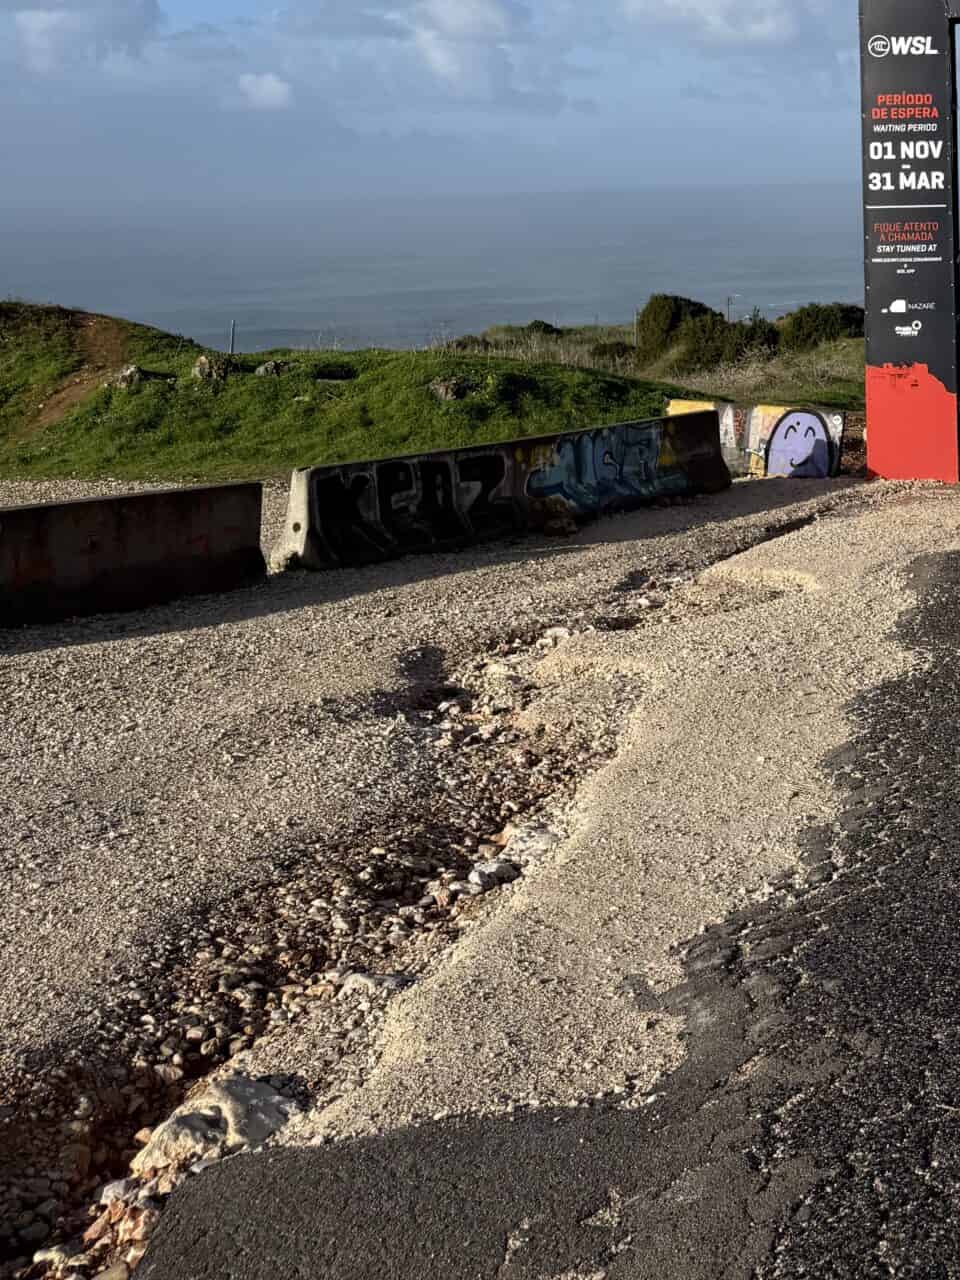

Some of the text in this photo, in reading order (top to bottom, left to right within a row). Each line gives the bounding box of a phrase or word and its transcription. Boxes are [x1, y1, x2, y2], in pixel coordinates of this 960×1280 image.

[891, 36, 939, 55] WSL
[871, 107, 939, 120] DE ESPERA
[873, 123, 938, 133] WAITING PERIOD
[869, 140, 943, 160] 01 NOV
[868, 171, 945, 190] 31 MAR
[873, 222, 939, 233] FIQUE ATENTO
[888, 232, 934, 242] CHAMADA
[876, 244, 938, 253] STAY TUNNED AT
